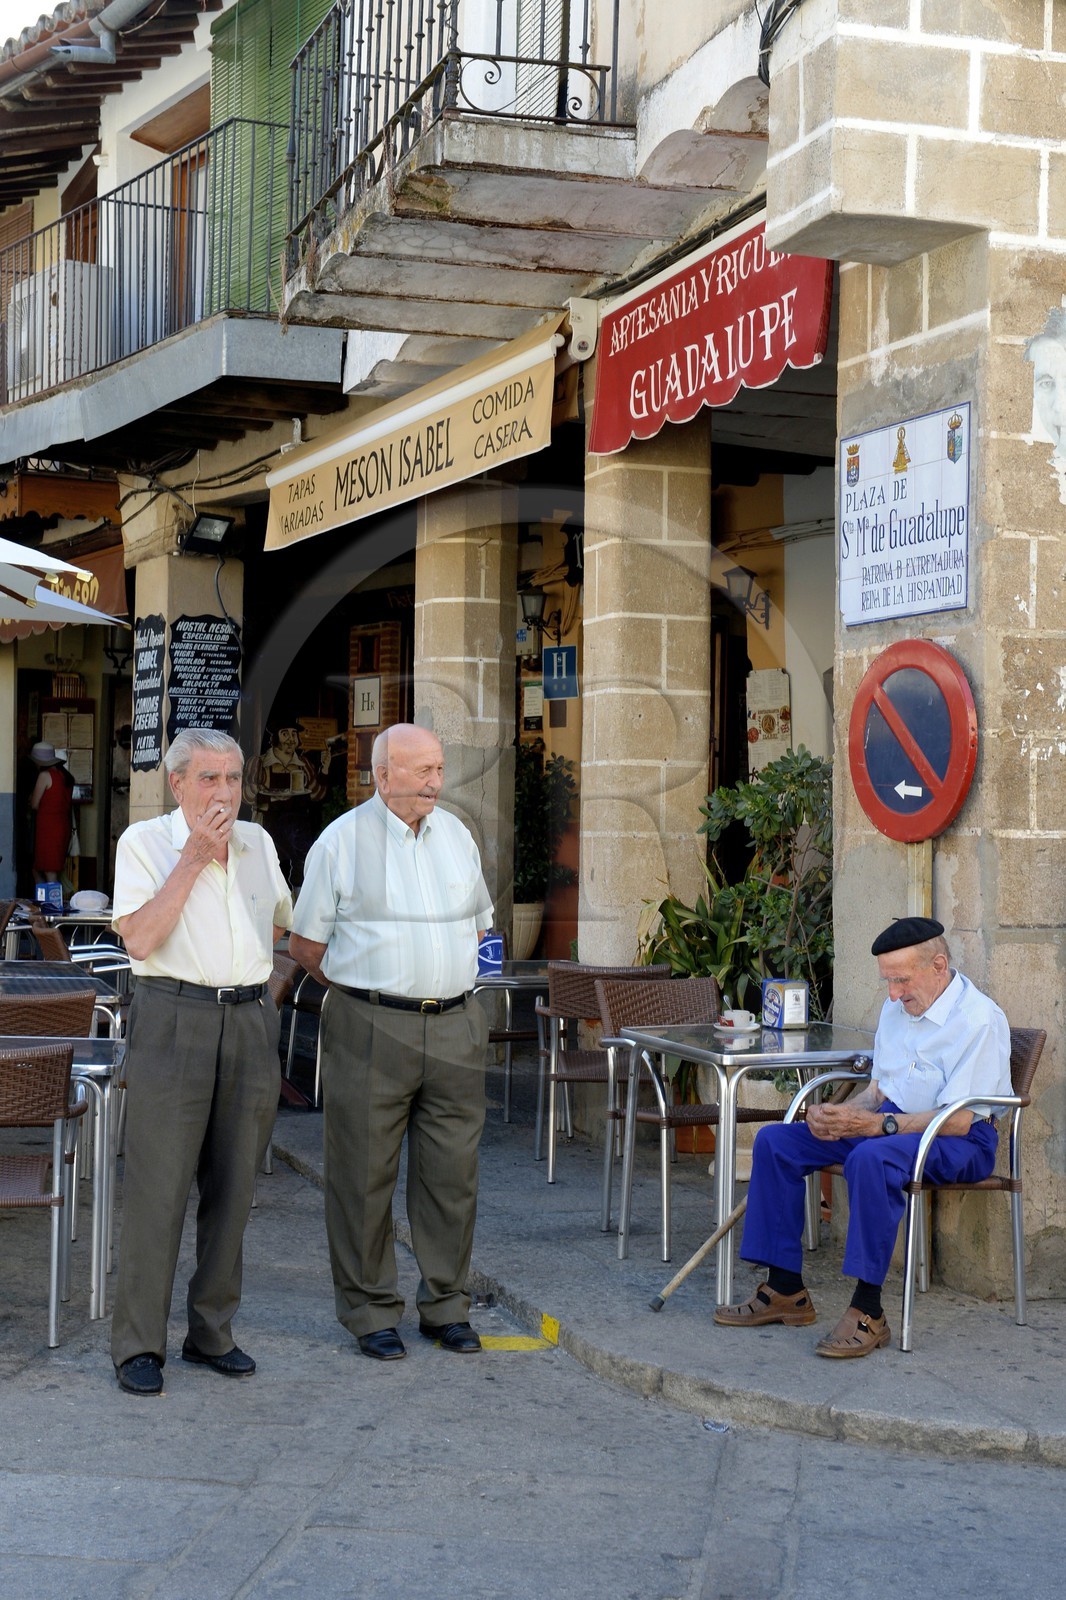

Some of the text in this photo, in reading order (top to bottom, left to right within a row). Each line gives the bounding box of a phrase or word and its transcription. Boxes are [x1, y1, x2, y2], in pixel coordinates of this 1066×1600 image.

[608, 275, 699, 357] ARTESANIA
[699, 254, 717, 303] Y
[629, 286, 798, 420] GUADALUPE
[472, 376, 534, 425] COMIDA
[473, 416, 533, 459] CASERA
[334, 417, 454, 512] MESON ISABEL
[288, 474, 315, 504] TAPAS
[845, 478, 907, 513] PLAZA DE
[871, 513, 885, 553] de
[889, 499, 966, 549] Guadalupe
[862, 562, 894, 586] PATRONA
[906, 549, 965, 577] EXTREMADURA
[861, 574, 963, 612] REINA DE LA HISPANIDAD
